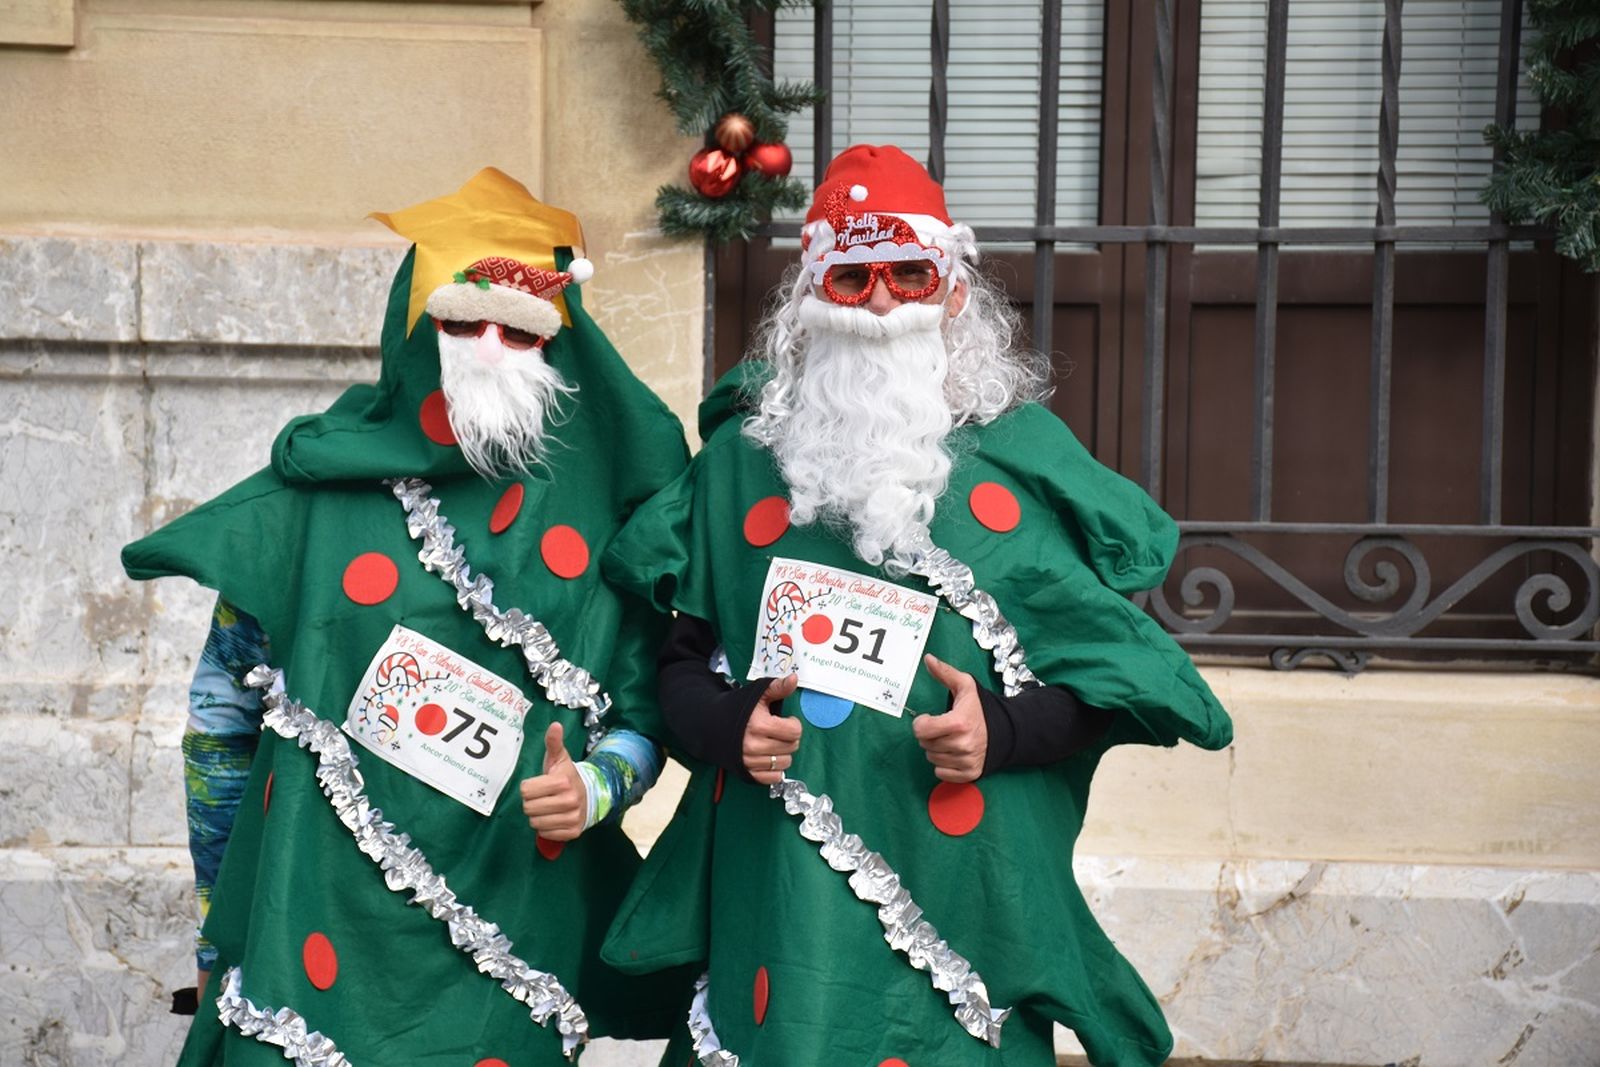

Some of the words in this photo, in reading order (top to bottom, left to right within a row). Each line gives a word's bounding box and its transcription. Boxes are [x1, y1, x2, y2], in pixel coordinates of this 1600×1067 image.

[838, 224, 895, 246] Navidad
[845, 213, 878, 232] Feliz
[789, 566, 807, 580] San
[809, 568, 846, 588] Silvestre
[848, 580, 885, 598] Ciudad
[882, 588, 902, 604] De
[903, 596, 931, 614] Ceuta
[845, 597, 862, 610] San
[833, 618, 887, 665] 51
[810, 655, 833, 667] Angel
[834, 661, 857, 674] David
[884, 677, 901, 689] Ruiz
[441, 707, 498, 760] 75
